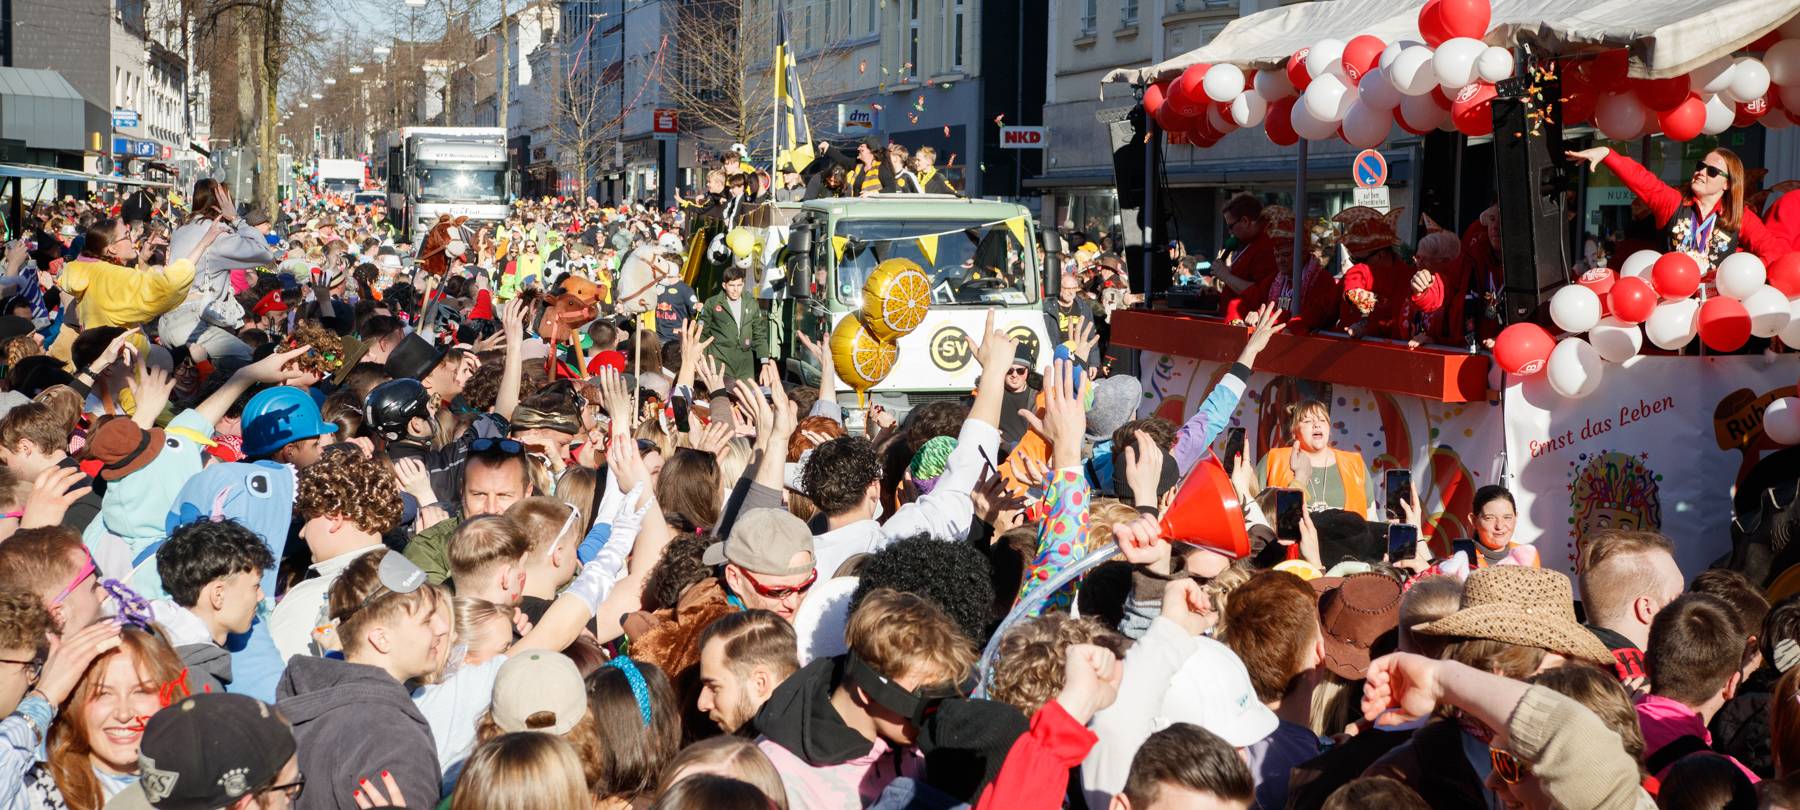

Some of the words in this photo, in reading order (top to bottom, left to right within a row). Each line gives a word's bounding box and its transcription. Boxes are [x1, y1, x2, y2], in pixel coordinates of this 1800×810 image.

[849, 109, 870, 122] dm
[1004, 130, 1041, 144] NKD
[1529, 430, 1575, 458] Ernst
[1580, 418, 1612, 440] das
[1619, 396, 1675, 426] Leben
